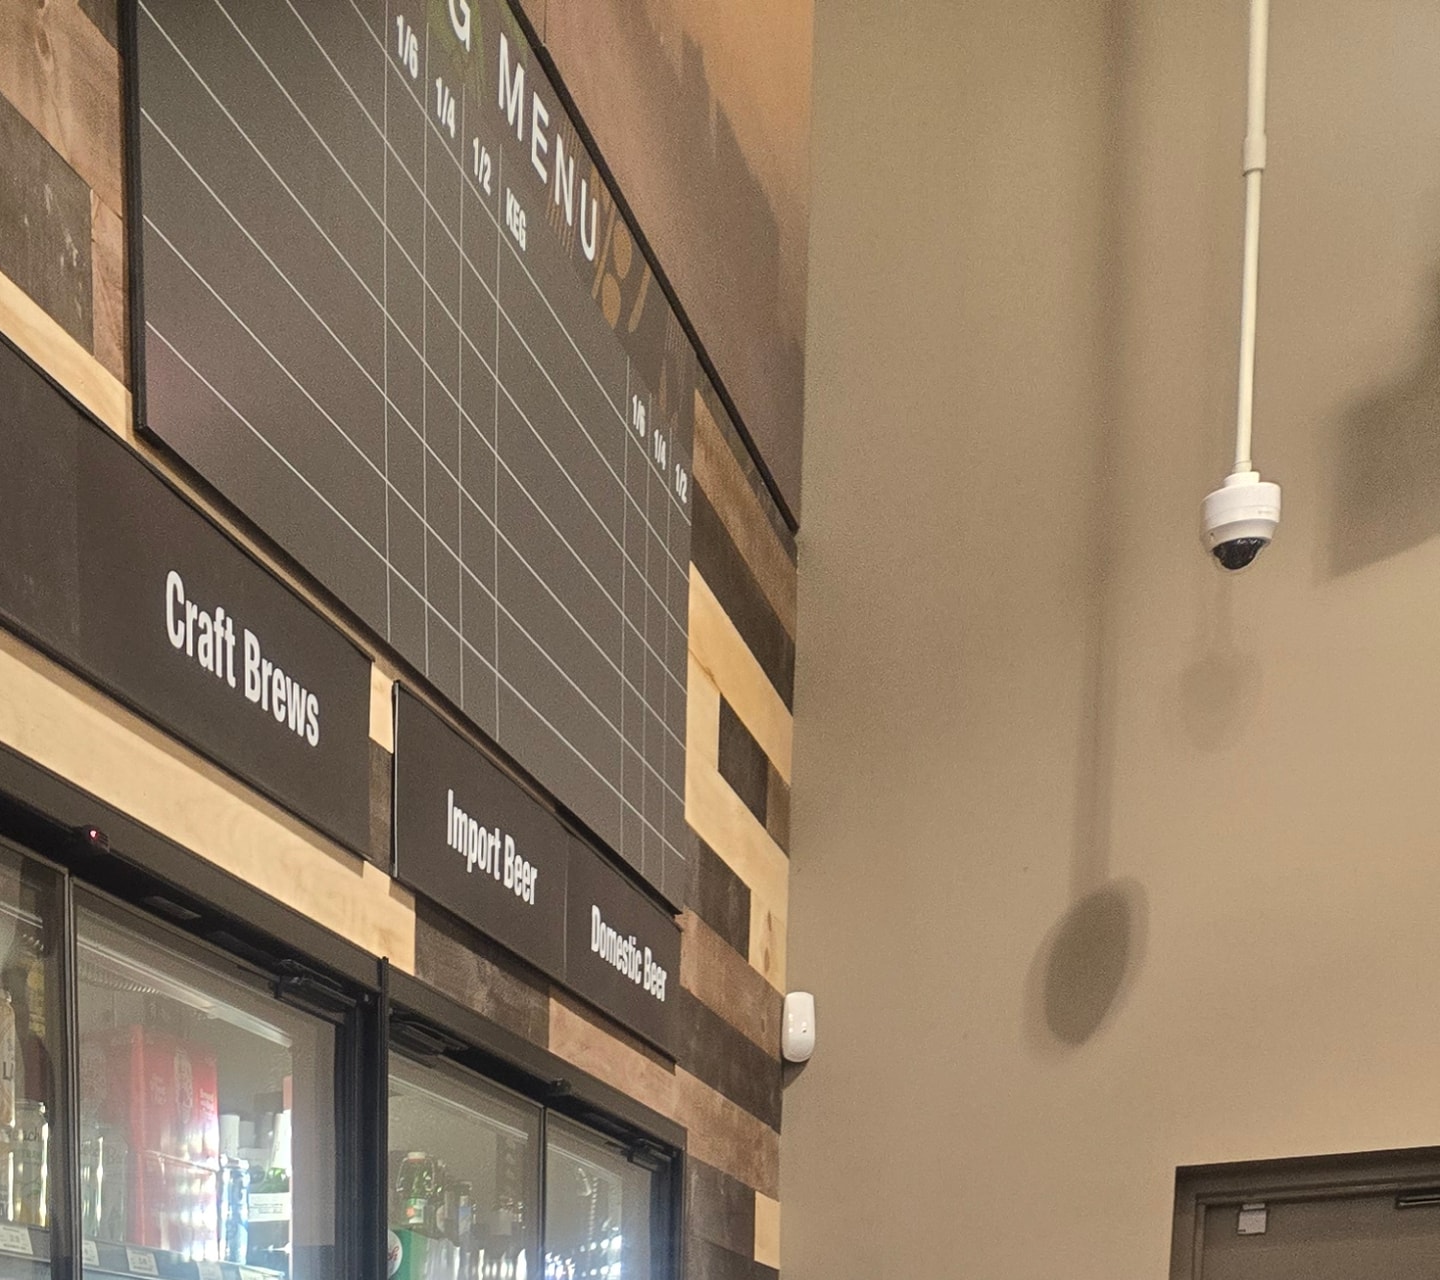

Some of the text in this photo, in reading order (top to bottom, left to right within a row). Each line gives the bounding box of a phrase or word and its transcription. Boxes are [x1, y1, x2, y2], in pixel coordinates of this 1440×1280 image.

[397, 15, 526, 251] 1/6 1/4 1/2 KEG
[498, 33, 597, 262] MENU
[632, 395, 687, 503] 1/6 1/4 1/2
[166, 572, 319, 747] Craft Brews
[447, 789, 538, 905] Import Beer
[591, 905, 666, 1001] Domestic Beer
